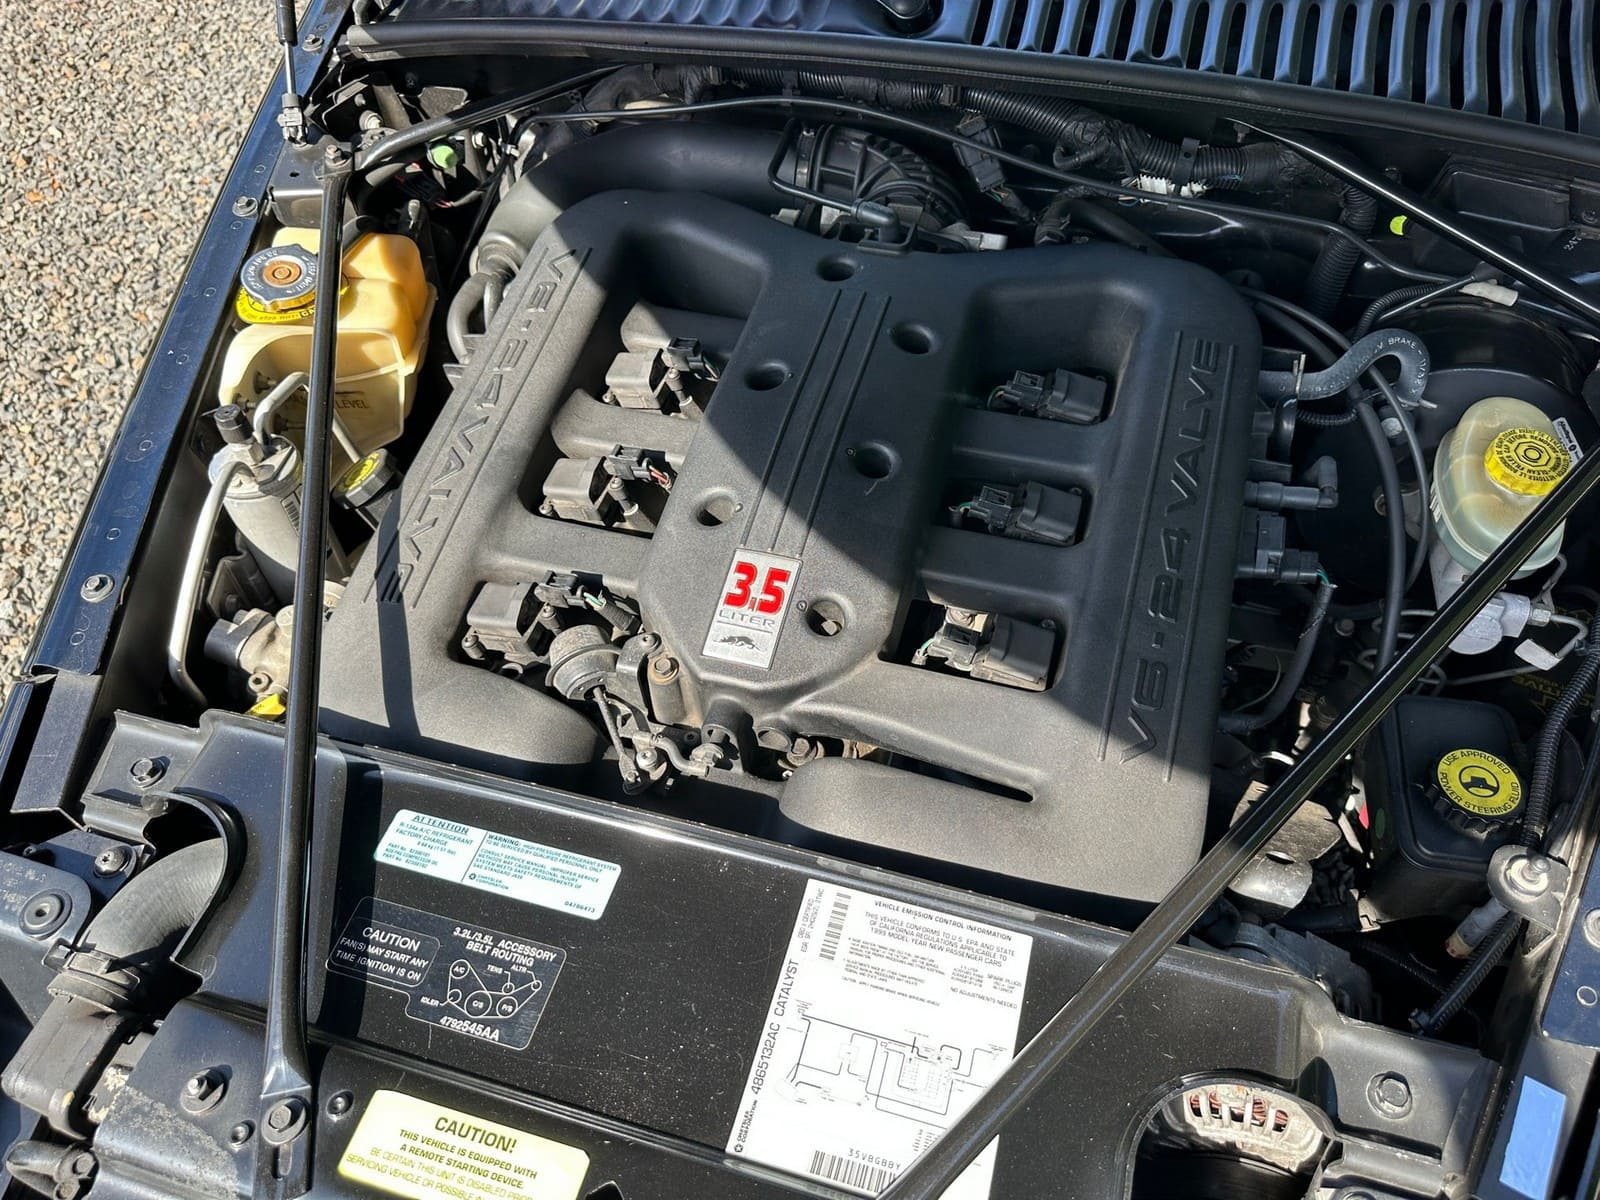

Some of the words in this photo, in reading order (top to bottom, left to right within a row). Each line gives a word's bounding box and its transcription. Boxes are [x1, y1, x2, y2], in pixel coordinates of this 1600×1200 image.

[1387, 336, 1418, 350] BRAKE
[1163, 337, 1220, 518] VALVE
[376, 414, 490, 603] VALVE
[723, 560, 791, 616] 3.5
[719, 610, 776, 628] LITER
[1443, 753, 1459, 766] USE
[1460, 751, 1510, 774] APPROVED
[1440, 772, 1463, 803] POWER
[1463, 801, 1512, 814] STEERING
[1508, 781, 1520, 804] FLUID
[394, 827, 422, 839] FACTORY
[422, 835, 448, 846] CHARGE
[412, 814, 469, 833] ATTENTION
[418, 826, 431, 834] A/C
[430, 830, 473, 845] REFRIGERANT
[500, 843, 525, 852] SERVICED
[532, 851, 558, 861] QUALIFIED
[558, 858, 588, 869] PERSONNEL
[588, 865, 602, 873] ONLY
[503, 854, 525, 863] SERVICE
[576, 873, 599, 883] SERVICE
[513, 862, 531, 870] CAUSE
[531, 867, 559, 878] PERSONAL
[596, 861, 617, 871] SYSTEM
[864, 910, 878, 919] THIS
[879, 914, 903, 926] VEHICLE
[905, 922, 940, 936] CONFORMS
[941, 931, 950, 939] TO
[965, 938, 979, 946] EPA
[980, 942, 994, 951] AND
[995, 946, 1015, 956] STATE
[874, 899, 899, 911] VEHICLE
[901, 906, 933, 920] EMISSION
[934, 915, 964, 929] CONTROL
[965, 924, 1012, 942] INFORMATION
[340, 937, 367, 952] FAN(S)
[366, 944, 385, 956] MAY
[384, 949, 412, 963] START
[411, 957, 428, 968] ANY
[361, 926, 420, 952] CAUTION
[452, 926, 495, 945] 3.2L/3.5L
[496, 938, 556, 962] ACCESSORY
[465, 940, 490, 954] BELT
[490, 947, 534, 967] ROUTING
[878, 922, 914, 936] CALIFORNIA
[915, 931, 958, 948] REGULATIONS
[959, 943, 996, 958] APPLICABLE
[887, 931, 908, 942] MODEL
[910, 937, 927, 947] YEAR
[928, 942, 944, 951] NEW
[945, 946, 983, 962] PASSENGER
[984, 957, 1002, 967] CARS
[336, 950, 356, 963] TIME
[356, 956, 396, 974] IGNITION
[394, 966, 406, 977] IS
[406, 970, 421, 981] ON
[453, 964, 465, 973] A/C
[420, 996, 439, 1006] IDLER
[471, 999, 484, 1008] C/S
[438, 1013, 501, 1040] 4792545AA
[749, 1021, 780, 1095] 4865132AC
[773, 958, 799, 1017] CATALYST
[432, 1115, 519, 1153] CAUTION!
[397, 1128, 419, 1142] THIS
[419, 1135, 456, 1153] VEHICLE
[456, 1146, 467, 1157] IS
[466, 1150, 513, 1171] EQUIPPED
[512, 1165, 538, 1179] WITH
[399, 1143, 408, 1151] A
[407, 1145, 445, 1163] REMOTE
[444, 1157, 490, 1178] STARTING
[346, 1154, 389, 1175] SERVICING
[389, 1167, 422, 1185] VEHICLE
[422, 1177, 434, 1188] OR
[369, 1146, 382, 1157] BE
[381, 1150, 417, 1168] CERTAIN
[415, 1161, 435, 1175] THIS
[435, 1168, 456, 1181] UNIT
[455, 1174, 466, 1185] IS
[465, 1177, 508, 1198] DISABLED
